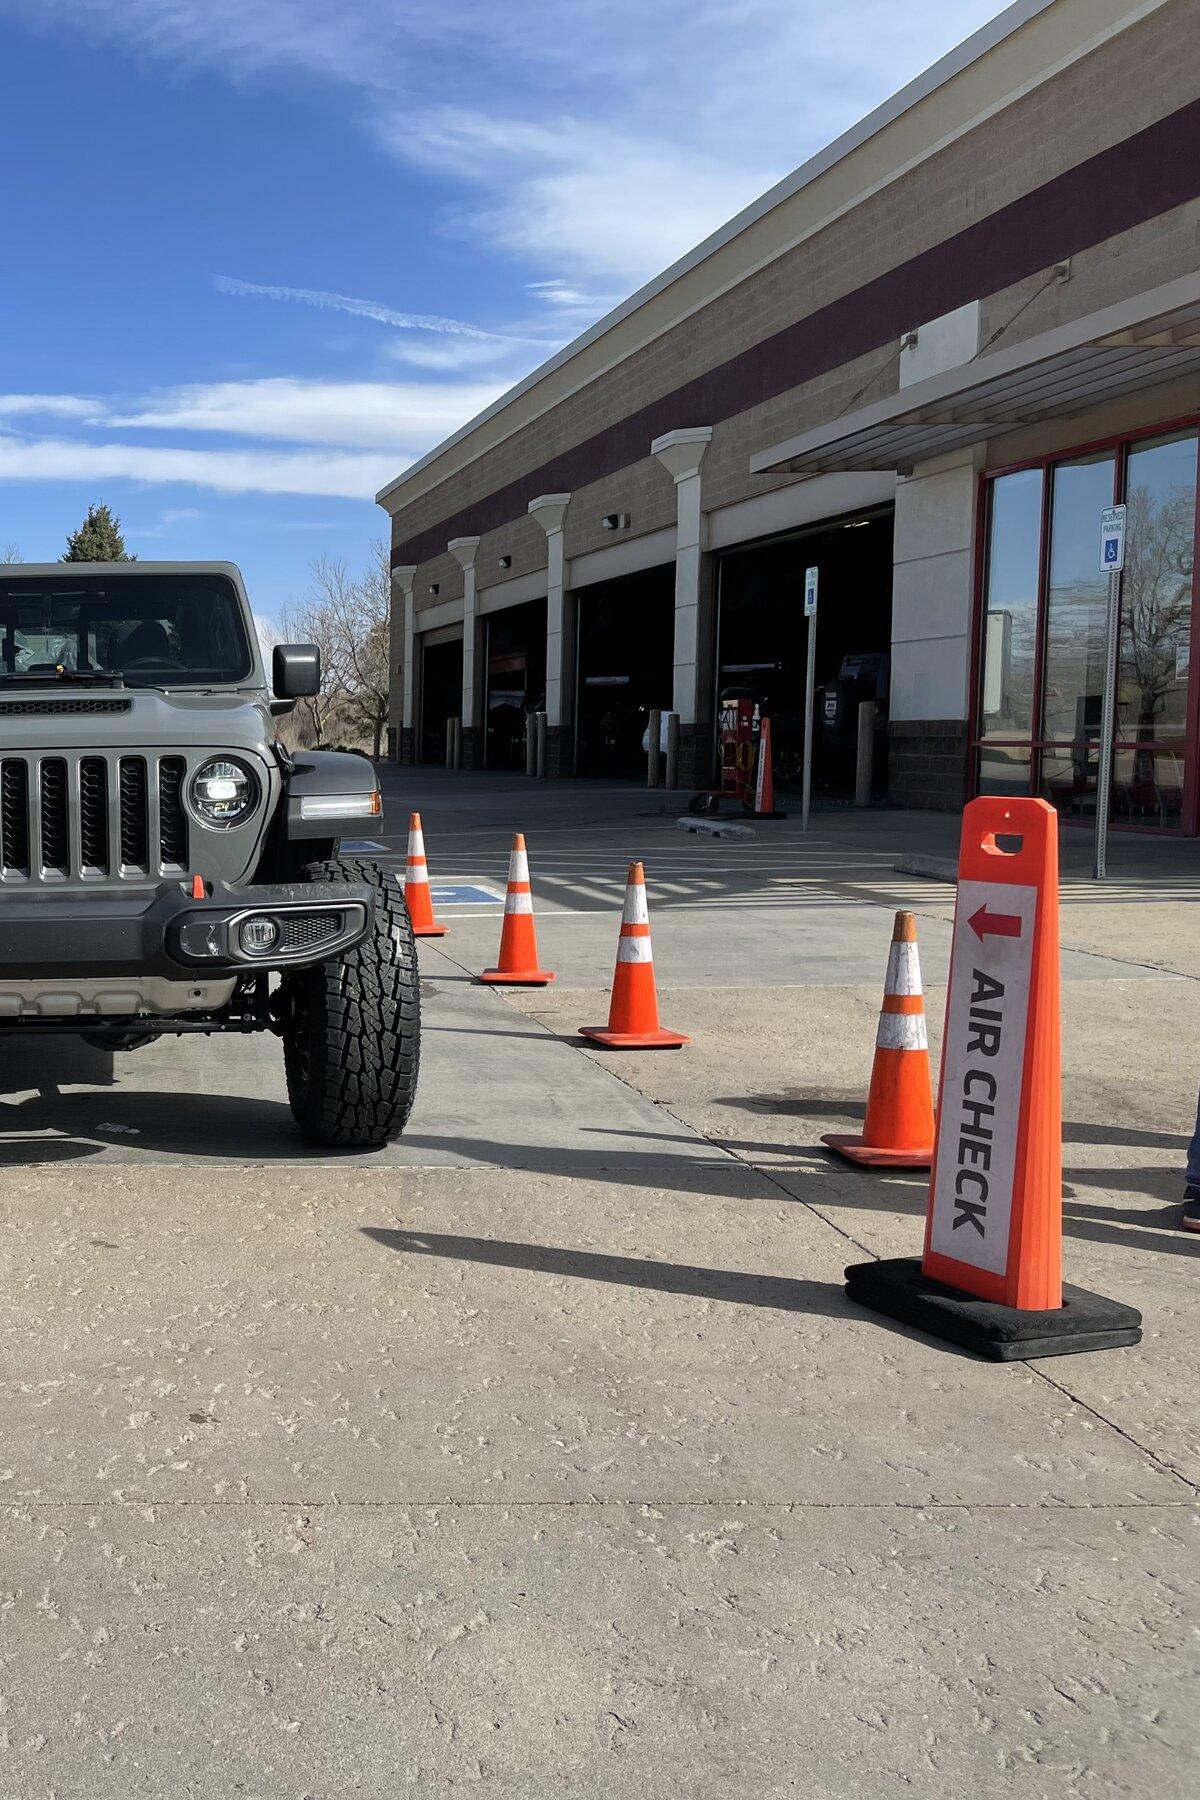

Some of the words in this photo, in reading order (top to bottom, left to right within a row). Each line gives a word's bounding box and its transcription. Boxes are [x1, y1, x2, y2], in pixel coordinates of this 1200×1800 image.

[1103, 523, 1122, 533] PARKING
[967, 968, 1005, 1057] AIR
[952, 1069, 997, 1239] CHECK
